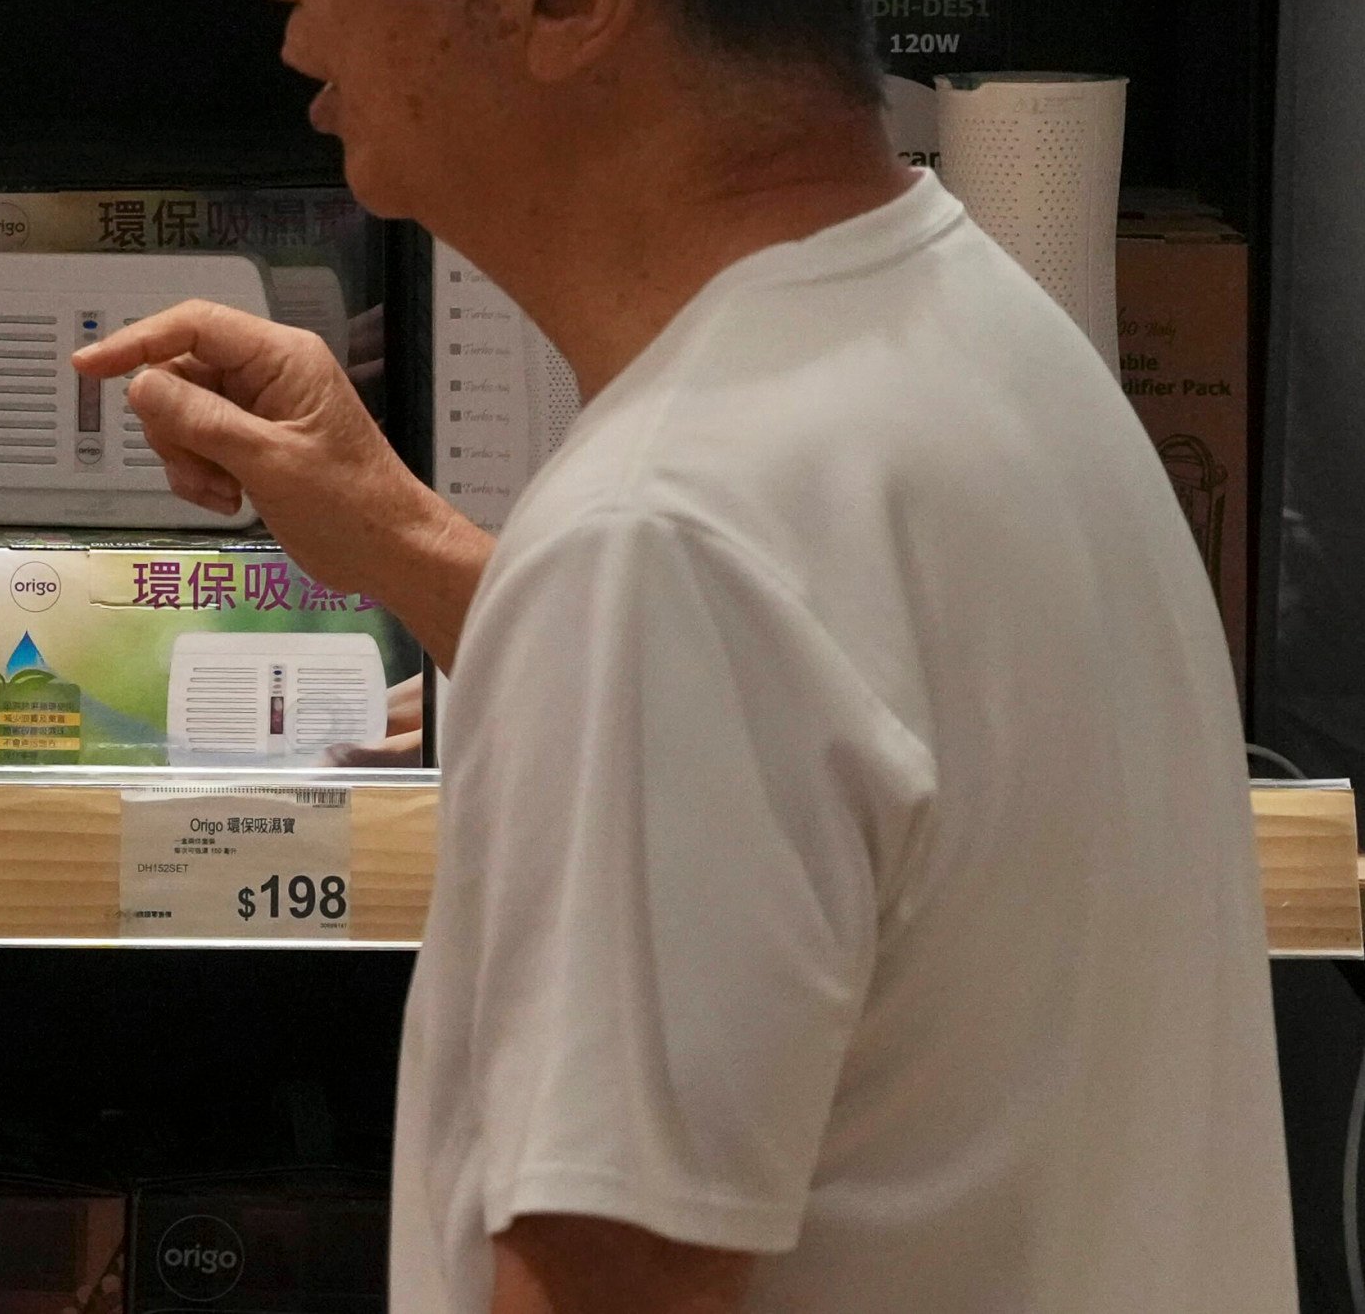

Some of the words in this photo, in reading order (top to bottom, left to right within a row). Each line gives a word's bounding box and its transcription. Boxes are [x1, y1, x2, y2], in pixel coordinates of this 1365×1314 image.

[889, 33, 960, 54] 120W
[1182, 378, 1232, 397] Pack
[14, 578, 57, 597] origo
[190, 818, 223, 835] Origo
[227, 818, 296, 834] 環保吸濕寶
[138, 864, 188, 873] DH152SET
[237, 875, 346, 921] $198
[163, 1243, 237, 1272] origo
